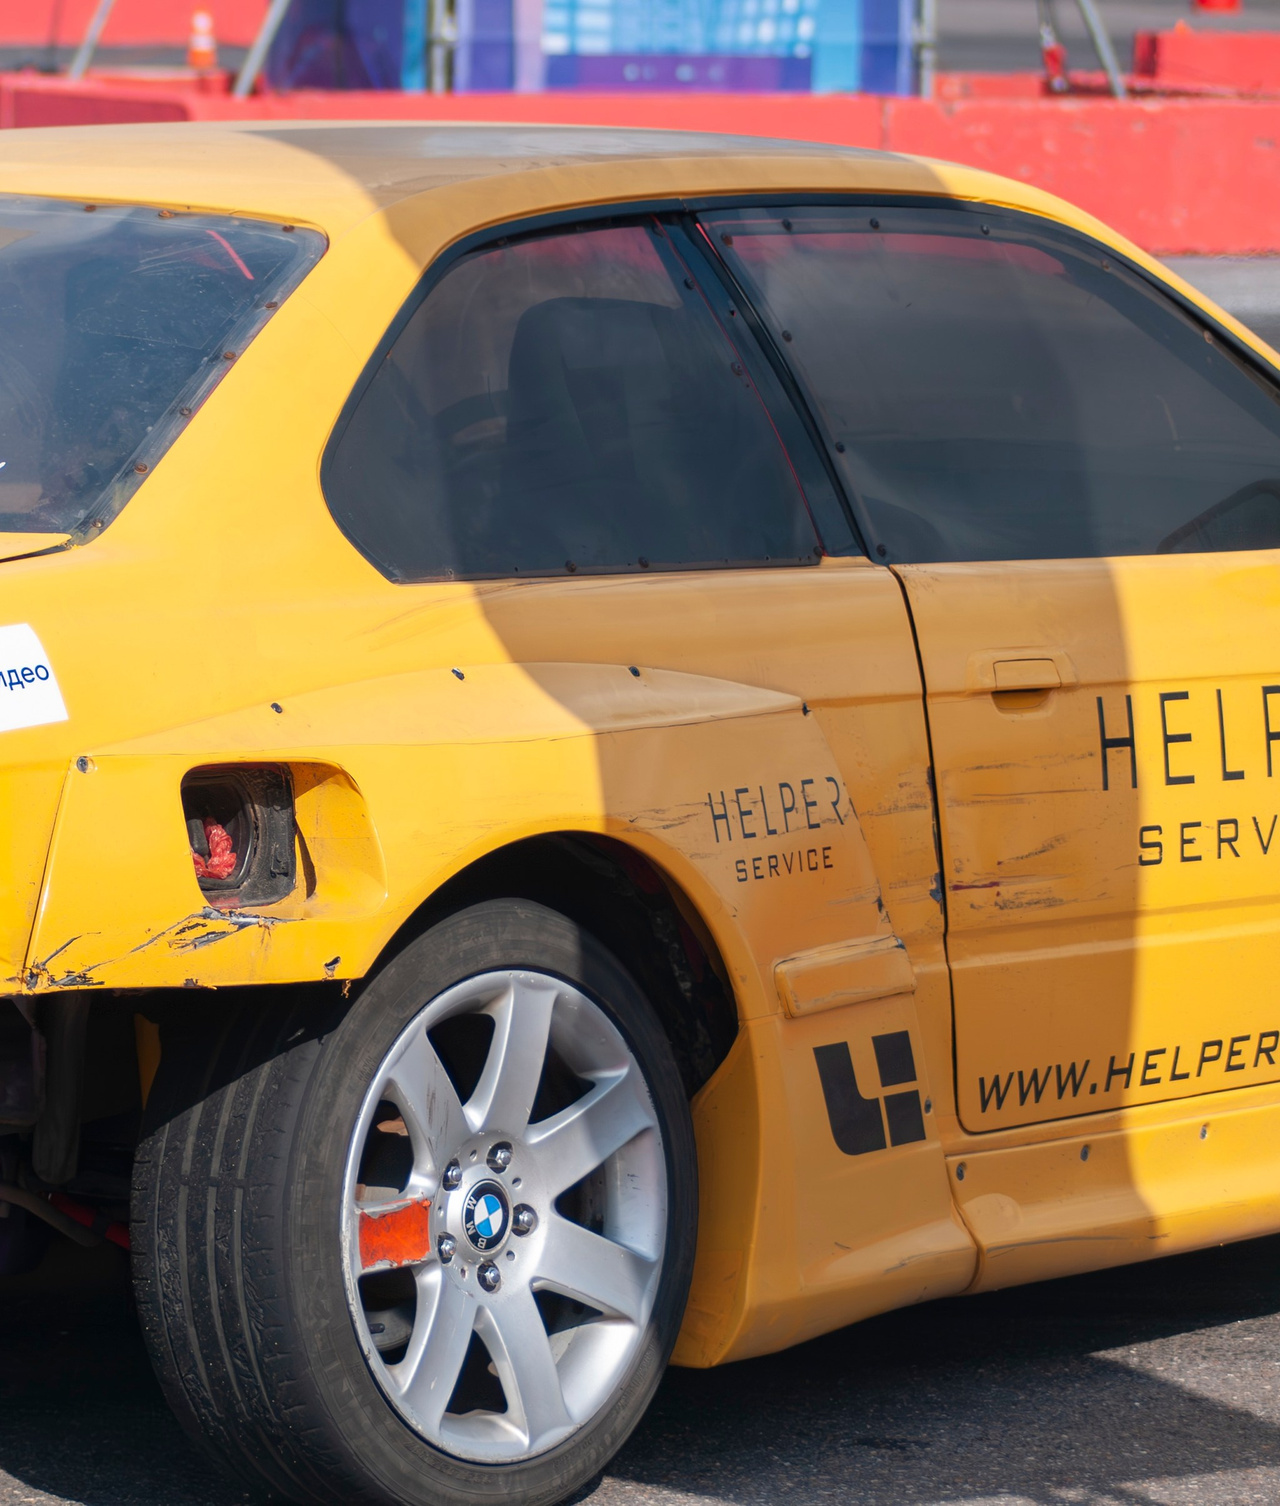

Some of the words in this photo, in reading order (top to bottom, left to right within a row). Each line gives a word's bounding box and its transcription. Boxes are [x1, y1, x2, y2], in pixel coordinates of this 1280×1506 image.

[707, 776, 845, 843] HELPER
[735, 846, 834, 883] SERVICE
[1138, 814, 1279, 867] SERV
[978, 1029, 1280, 1114] WWW.HELPER
